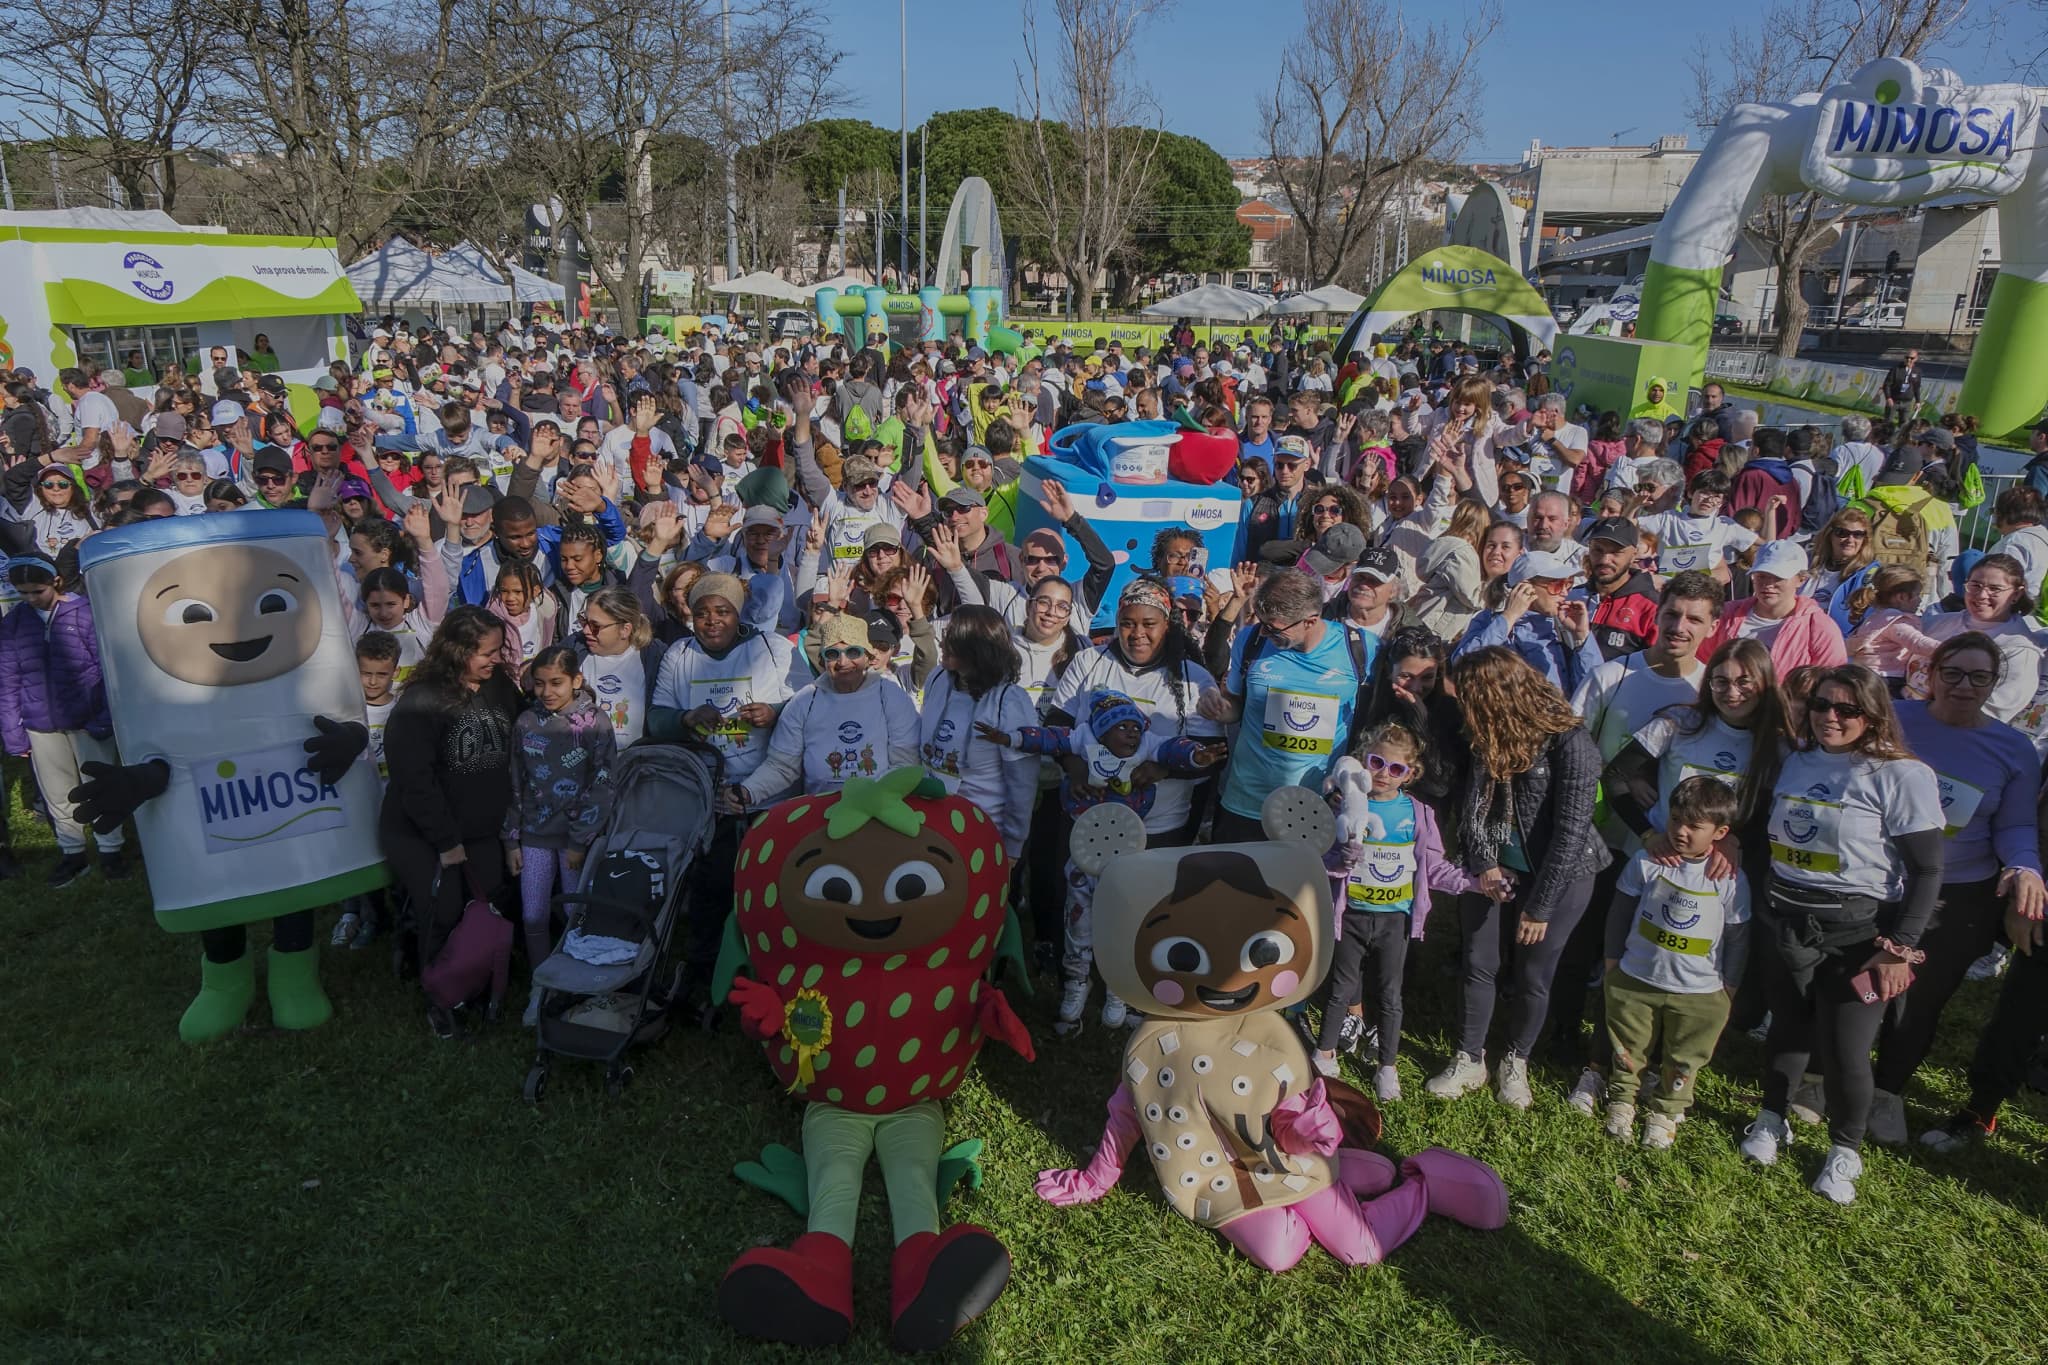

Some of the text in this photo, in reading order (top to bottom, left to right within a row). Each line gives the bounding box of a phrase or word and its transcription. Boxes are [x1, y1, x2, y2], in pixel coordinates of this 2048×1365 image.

[1834, 102, 2014, 159] MIMOSA
[252, 265, 274, 274] Uma
[274, 267, 296, 277] prova
[296, 266, 306, 274] de
[1422, 266, 1497, 285] MIMOSA
[888, 302, 914, 310] MIMOSA
[1062, 327, 1093, 338] MIMOSA
[1110, 329, 1142, 340] MIMOSA
[1191, 508, 1223, 519] MIMOSA
[846, 546, 863, 555] 938
[710, 686, 734, 694] MIMOSA
[1288, 699, 1317, 711] MIMOSA
[1279, 735, 1318, 751] 2203
[1789, 809, 1814, 821] MIMOSA
[1373, 851, 1401, 861] MIMOSA
[1787, 848, 1812, 866] 834
[1366, 888, 1402, 901] 2204
[1669, 894, 1698, 910] MIMOSA
[1657, 931, 1689, 950] 883
[791, 1012, 822, 1029] MIMOSA
